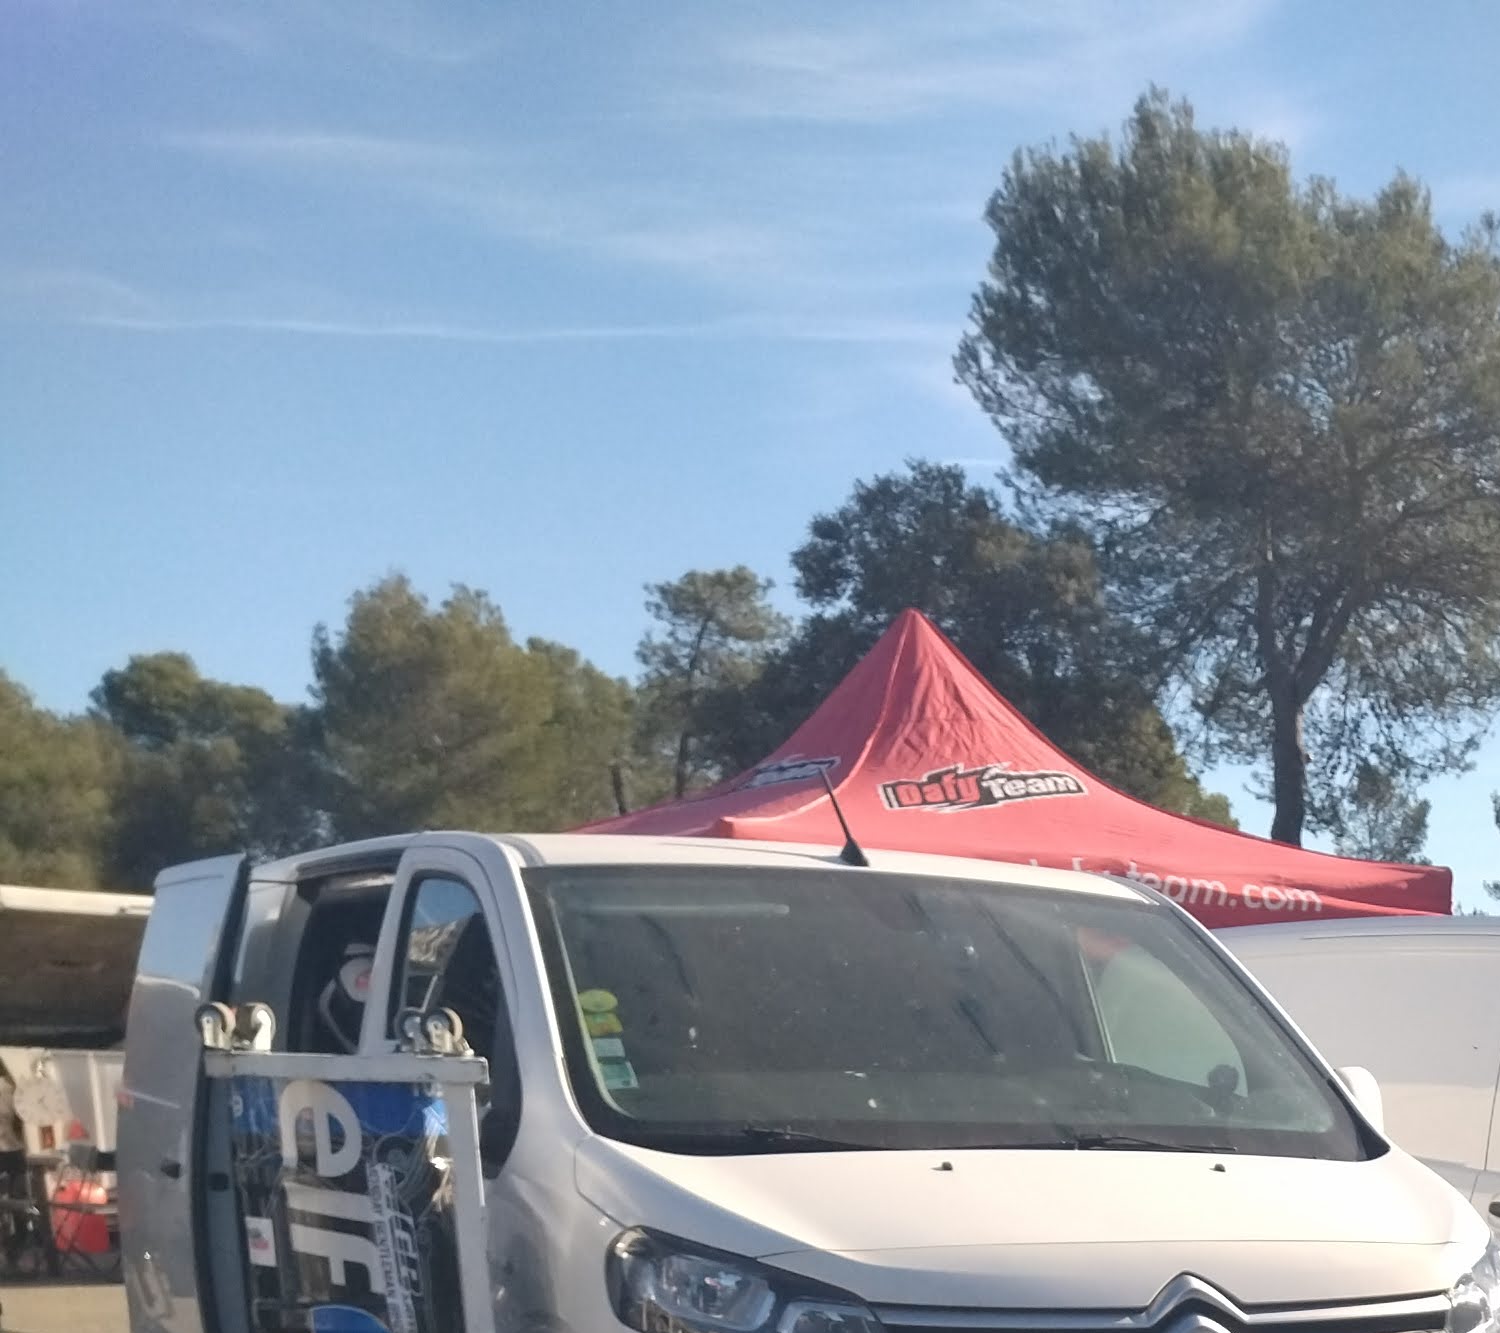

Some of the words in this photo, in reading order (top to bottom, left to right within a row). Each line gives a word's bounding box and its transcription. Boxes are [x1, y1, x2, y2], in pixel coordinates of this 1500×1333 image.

[895, 773, 981, 805] Dafy
[980, 774, 1078, 800] Team
[279, 1079, 389, 1296] elf
